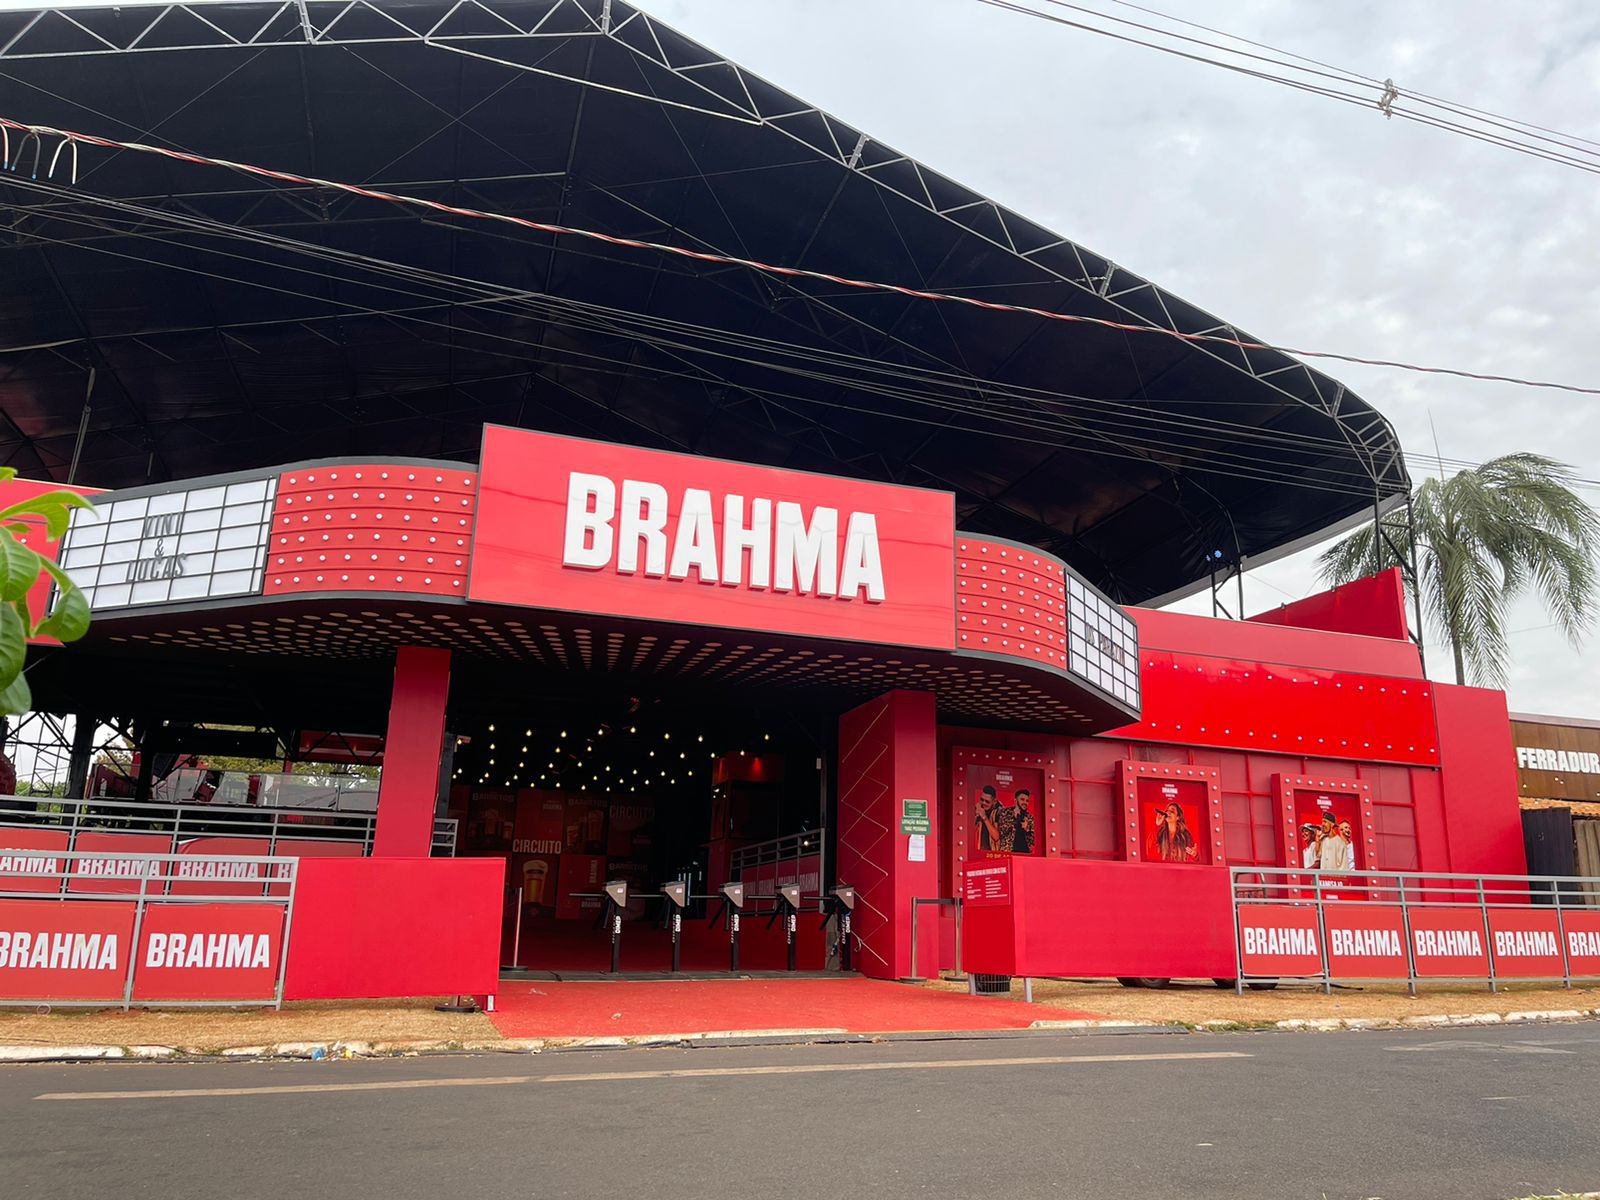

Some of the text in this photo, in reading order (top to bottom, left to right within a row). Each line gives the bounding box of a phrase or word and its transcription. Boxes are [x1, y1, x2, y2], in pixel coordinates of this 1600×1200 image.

[144, 512, 181, 538] VINI
[562, 471, 887, 604] BRAHMA
[154, 538, 164, 563] &
[125, 553, 187, 583] LUCAS
[513, 838, 563, 855] CIRCUITO
[179, 861, 259, 879] BRAHMA
[0, 931, 118, 970] BRAHMA
[145, 933, 270, 968] BRAHMA
[1243, 927, 1318, 956] BRAHMA
[1330, 929, 1403, 957] BRAHMA
[1414, 930, 1483, 957] BRAHMA
[1494, 931, 1559, 957] BRAHMA
[1568, 932, 1600, 957] BRA
